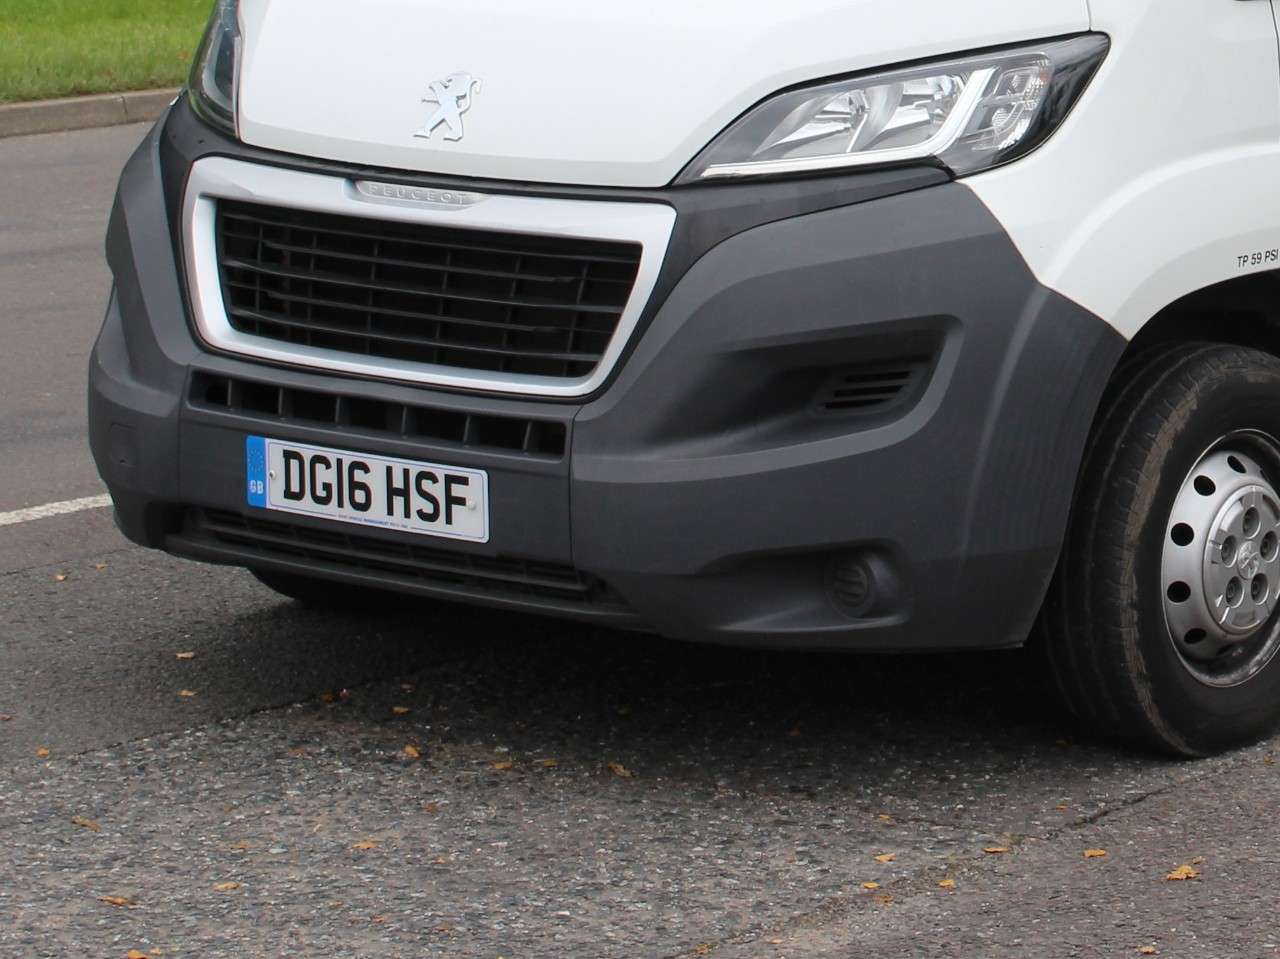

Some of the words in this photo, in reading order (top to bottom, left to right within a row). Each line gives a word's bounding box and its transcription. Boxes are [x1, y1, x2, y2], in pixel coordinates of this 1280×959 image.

[368, 183, 467, 205] PEUGEOT
[1237, 254, 1249, 268] TP
[1250, 251, 1262, 265] 59
[1264, 248, 1279, 262] PSI
[250, 479, 264, 495] GB
[282, 448, 373, 513] DG16
[385, 464, 470, 526] HSF
